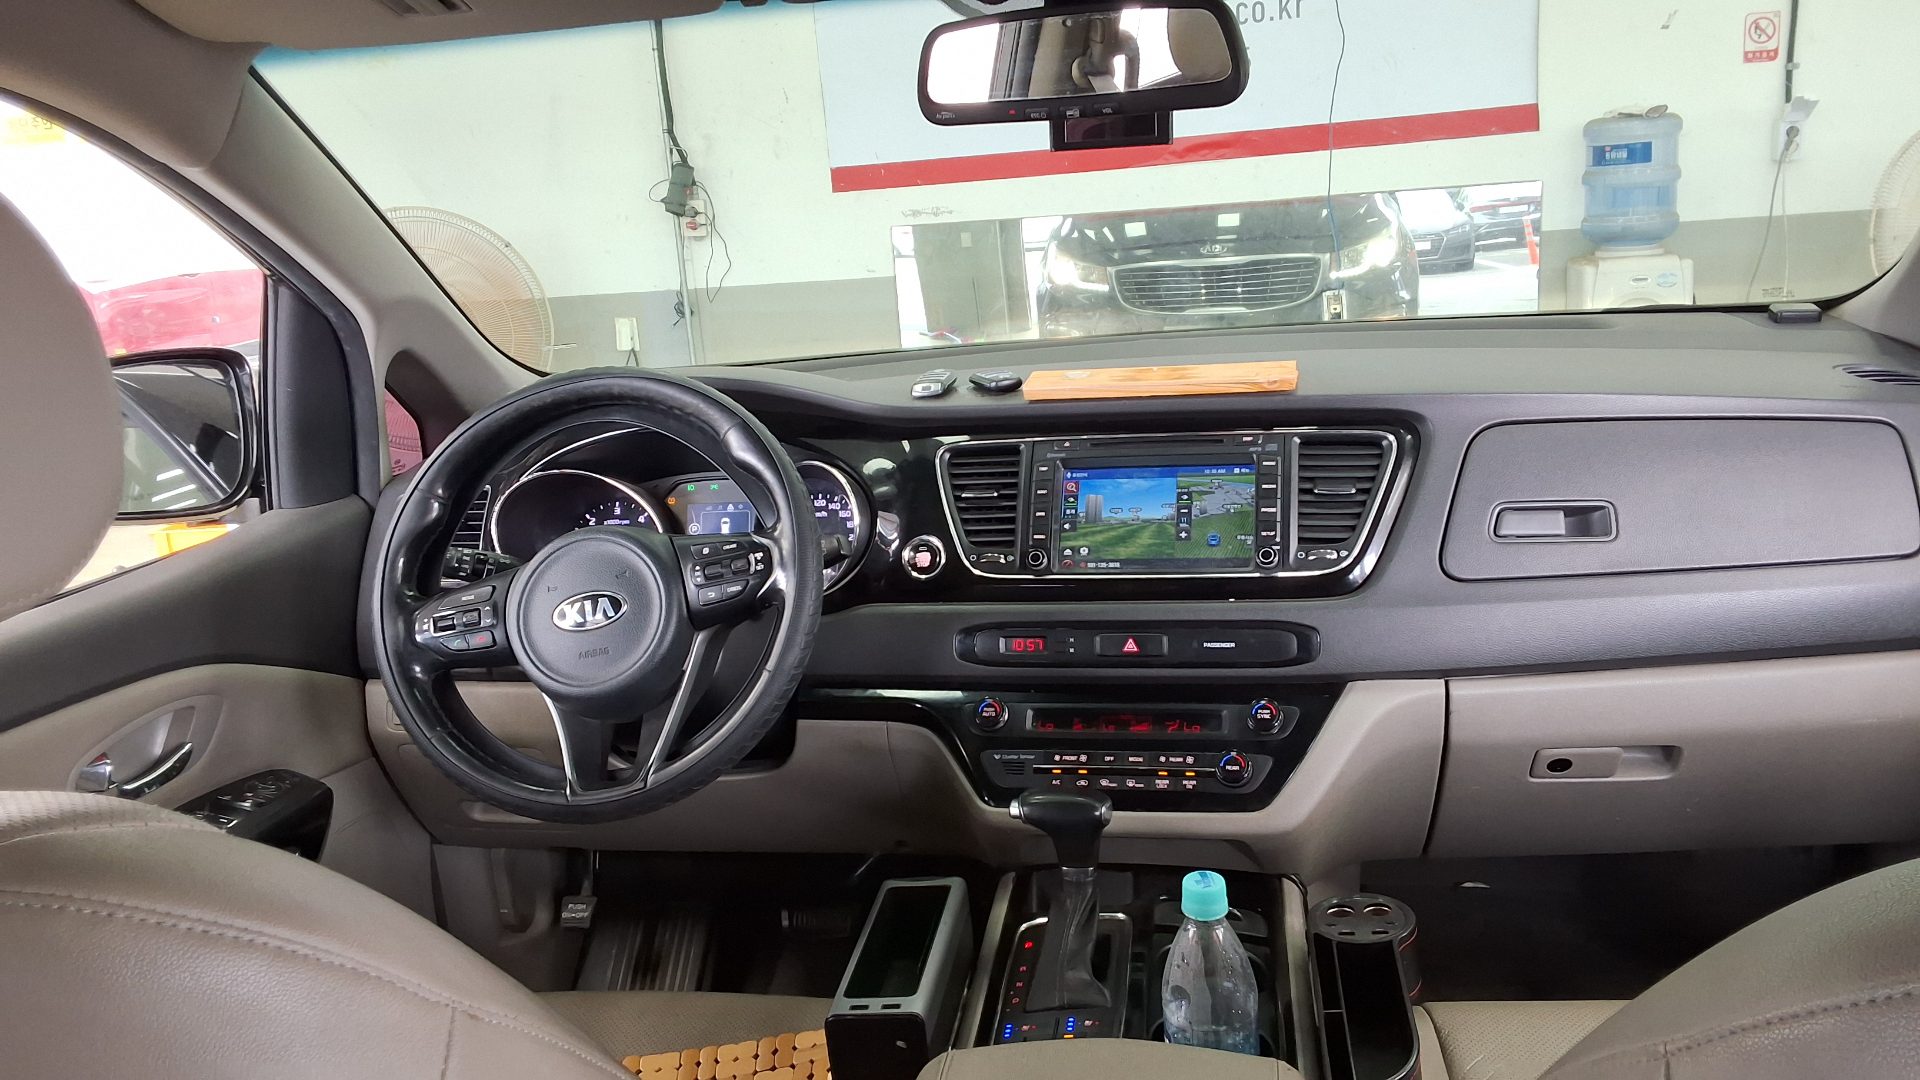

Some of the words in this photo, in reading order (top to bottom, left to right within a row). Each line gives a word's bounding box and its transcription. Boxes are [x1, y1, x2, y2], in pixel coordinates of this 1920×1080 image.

[813, 499, 827, 507] 120
[828, 502, 841, 510] 140
[613, 507, 621, 515] 3
[589, 517, 596, 526] 2
[637, 515, 645, 523] 4
[563, 597, 616, 623] KIA
[578, 646, 611, 660] AIRBAG
